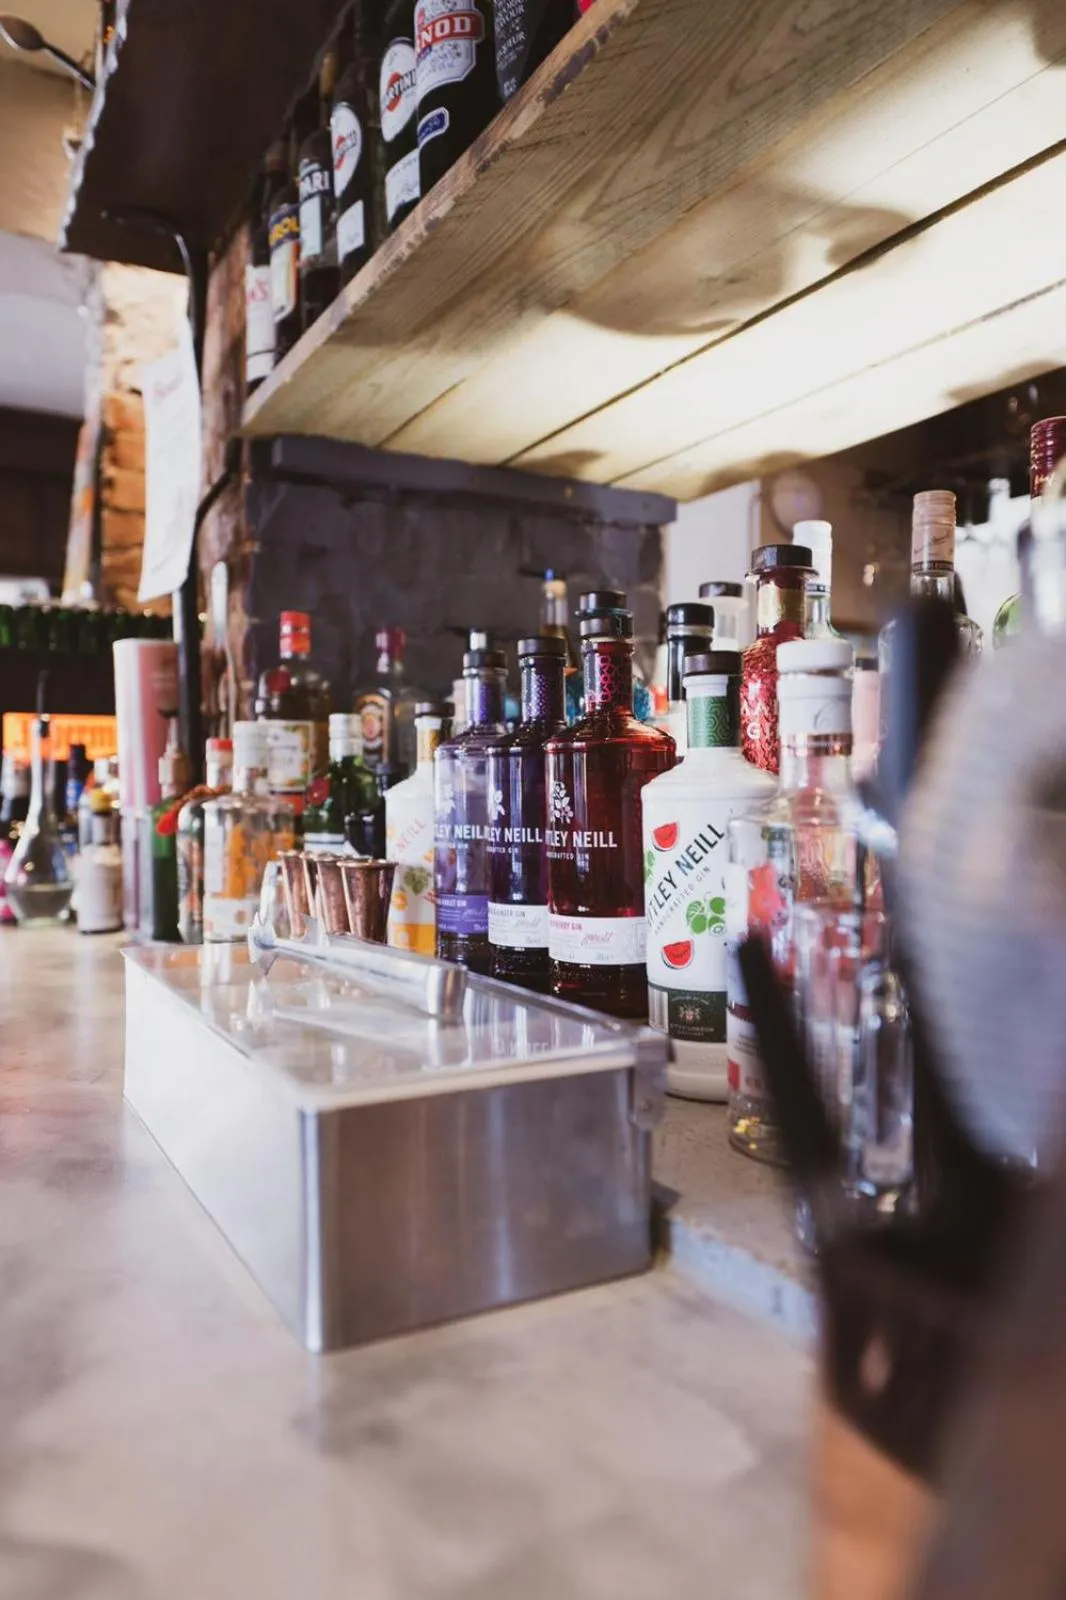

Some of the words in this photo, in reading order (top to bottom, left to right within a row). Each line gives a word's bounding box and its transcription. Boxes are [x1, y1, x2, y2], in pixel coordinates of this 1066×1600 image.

[504, 827, 543, 843] NEILL
[572, 831, 618, 848] NEILL
[675, 823, 725, 877] NEILL
